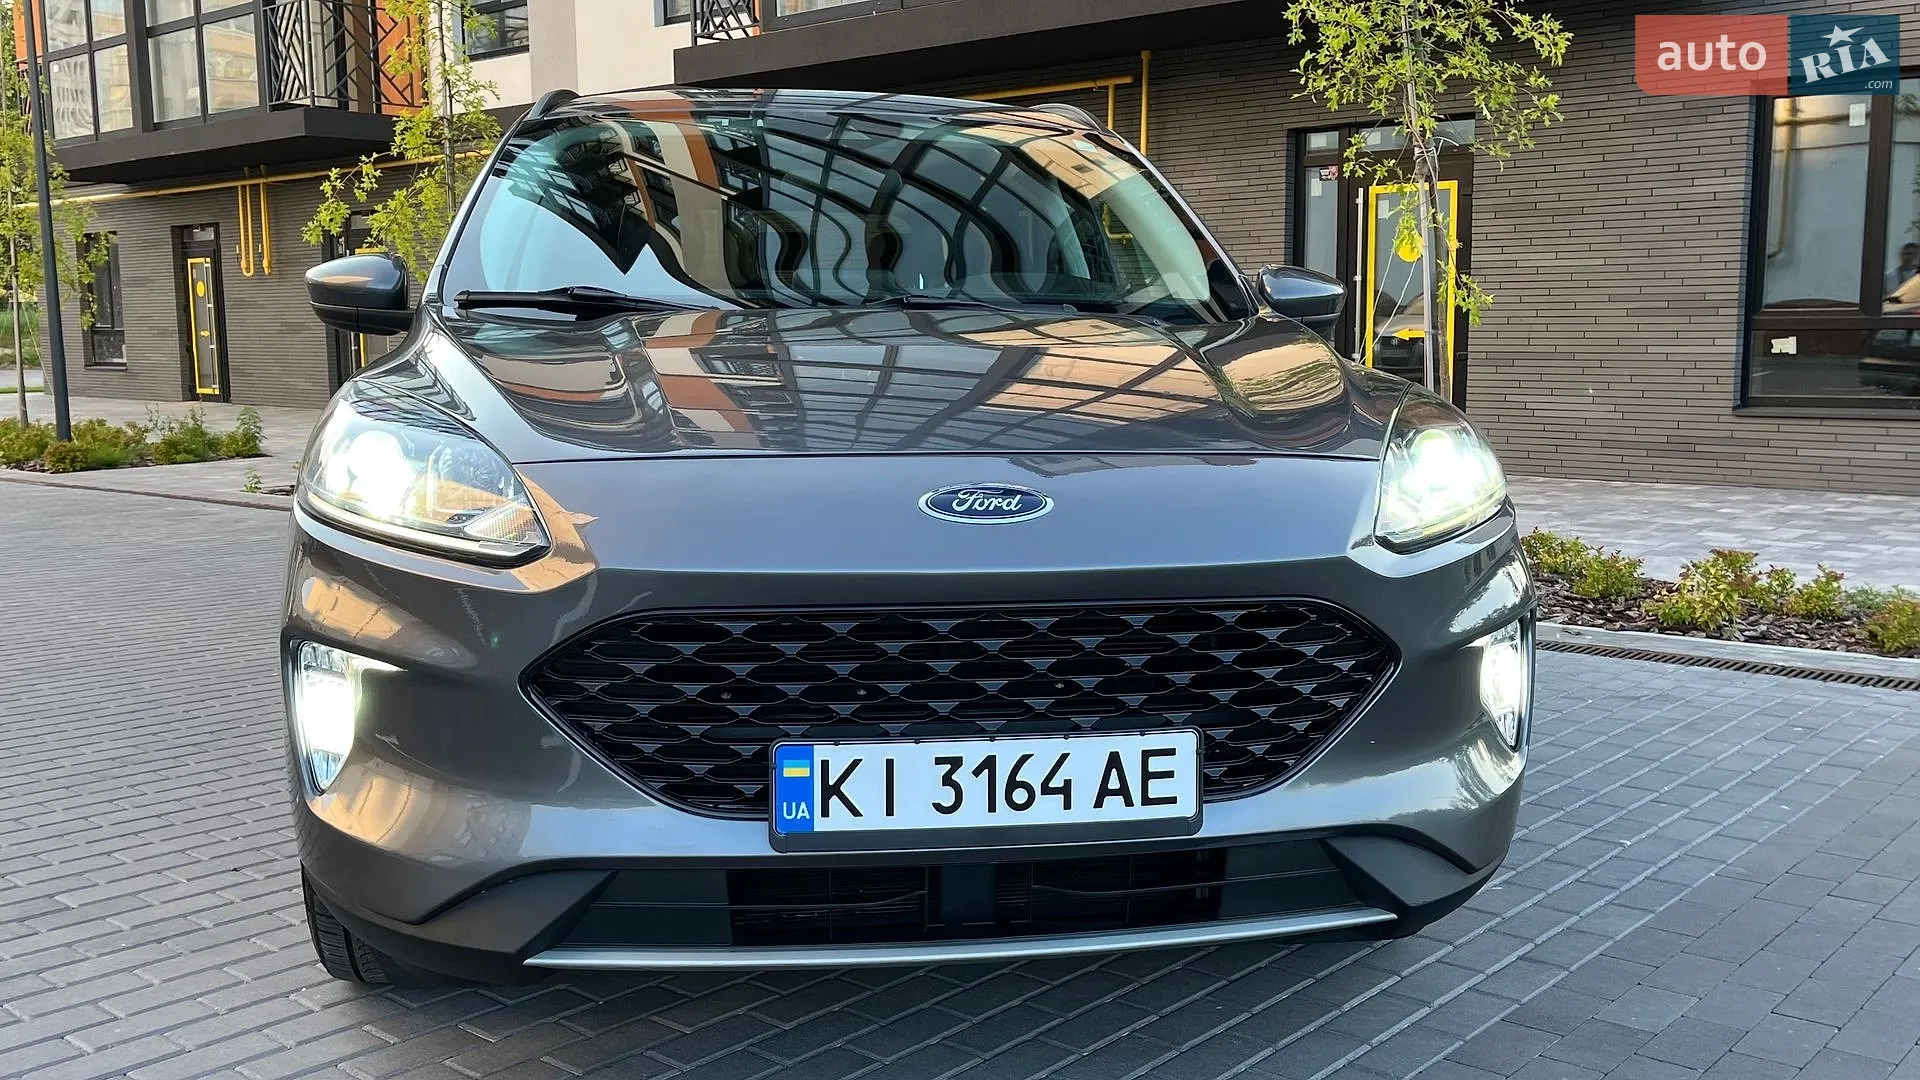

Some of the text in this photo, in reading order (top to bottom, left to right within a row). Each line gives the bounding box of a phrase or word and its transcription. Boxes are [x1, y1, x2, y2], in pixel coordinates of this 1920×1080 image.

[952, 489, 1022, 511] Ford
[820, 747, 1178, 818] KI 3164 AE
[783, 801, 810, 820] UA
